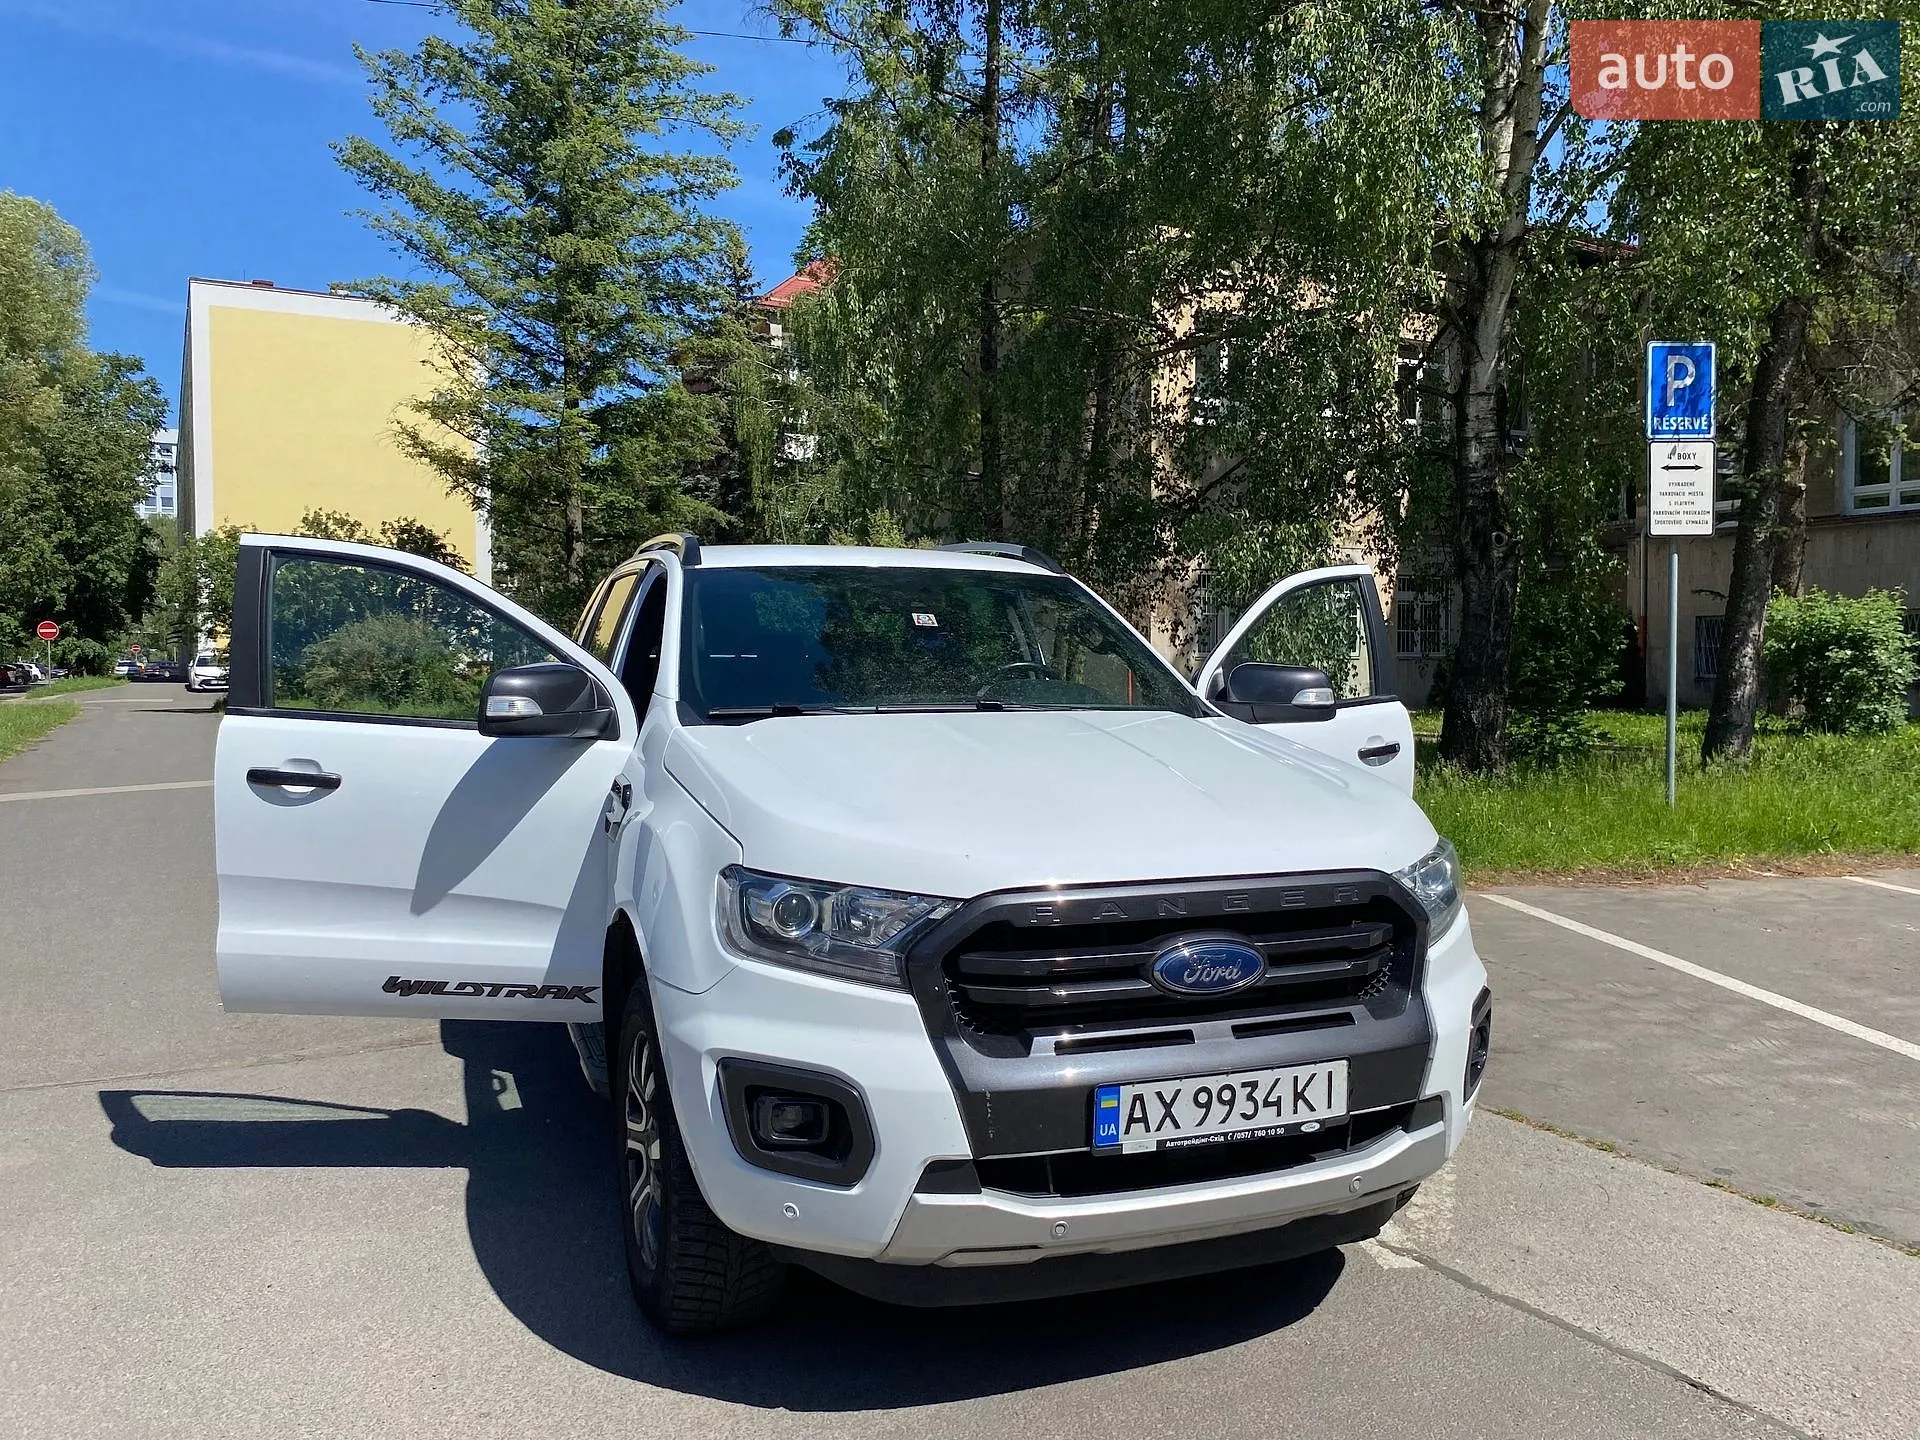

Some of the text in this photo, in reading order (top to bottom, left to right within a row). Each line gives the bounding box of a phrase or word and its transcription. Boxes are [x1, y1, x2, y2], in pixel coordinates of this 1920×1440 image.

[1666, 355, 1696, 407] P
[1653, 414, 1708, 430] RÉSERVÉ
[1677, 452, 1697, 460] BOXY
[1030, 886, 1360, 923] RANGER
[1183, 952, 1243, 984] Ford
[382, 975, 601, 1004] WILDTRAK
[1124, 1070, 1333, 1135] AX 9934 KI
[1100, 1124, 1117, 1137] UA
[1268, 1128, 1276, 1136] 10
